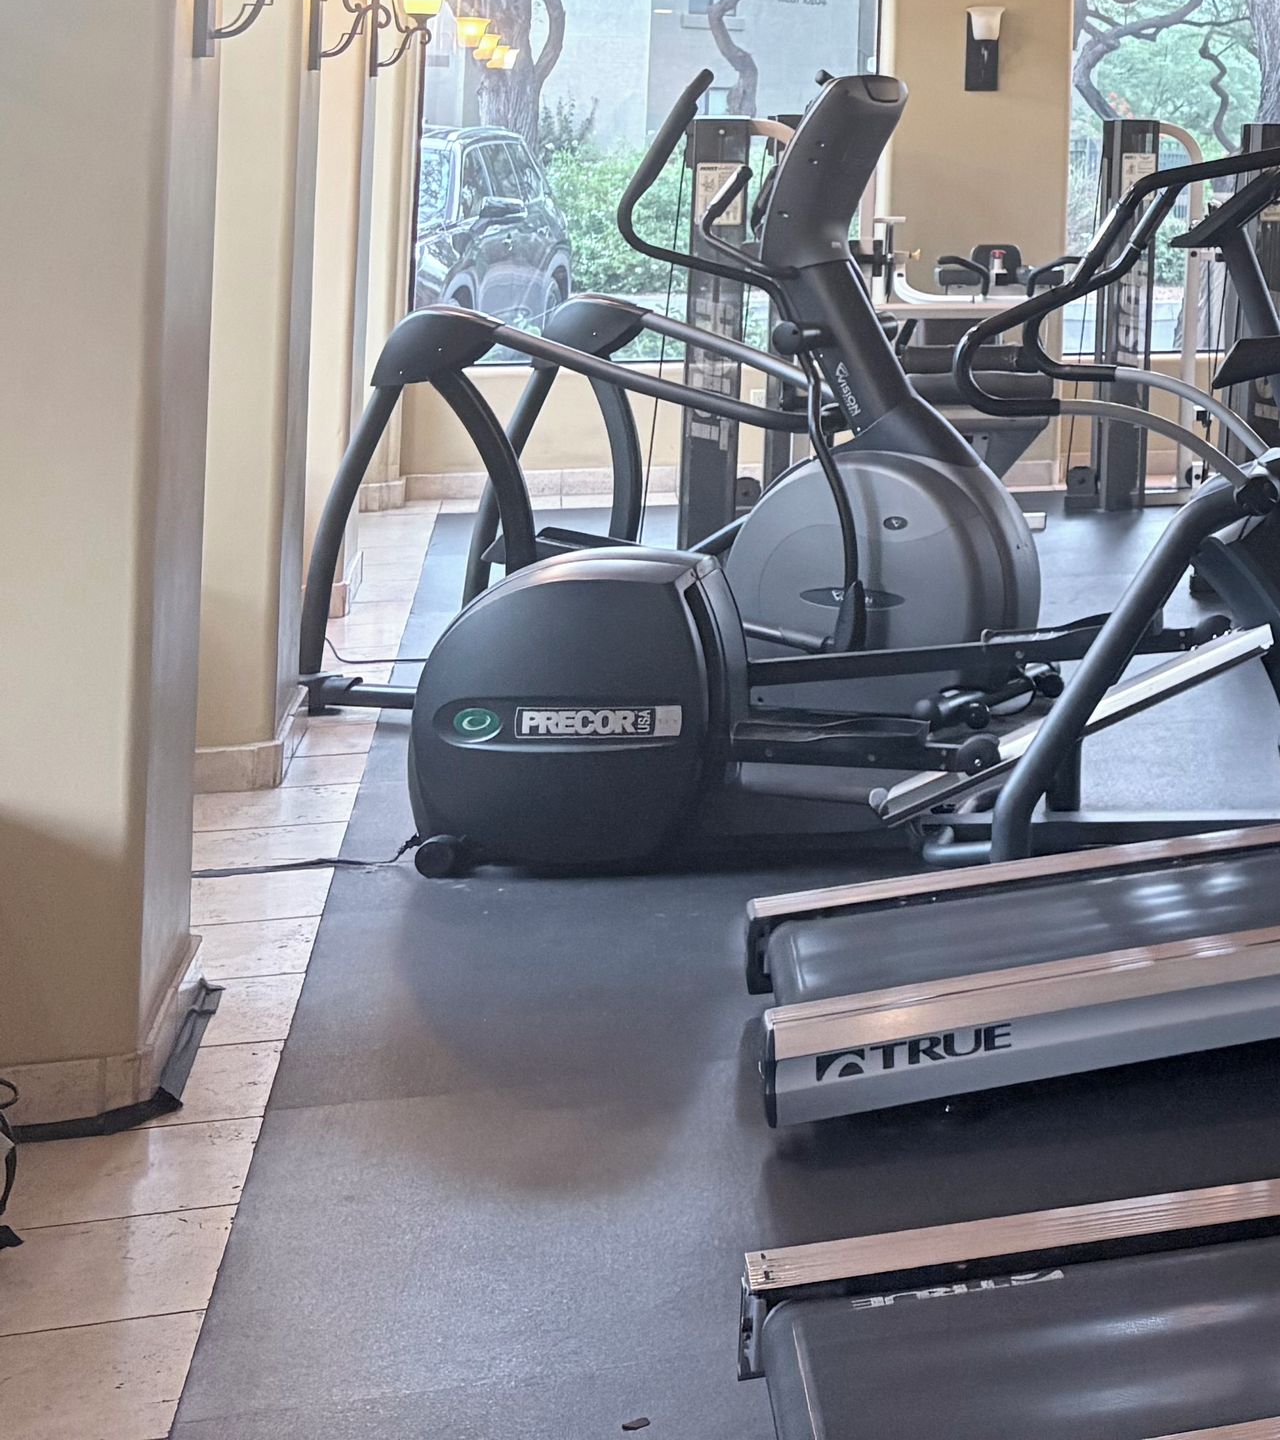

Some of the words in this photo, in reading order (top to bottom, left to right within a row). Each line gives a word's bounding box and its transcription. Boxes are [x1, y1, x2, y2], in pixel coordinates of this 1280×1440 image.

[837, 376, 862, 417] VISION
[521, 709, 637, 735] PRECOR
[637, 709, 652, 733] USA
[869, 1022, 1012, 1070] TRUE
